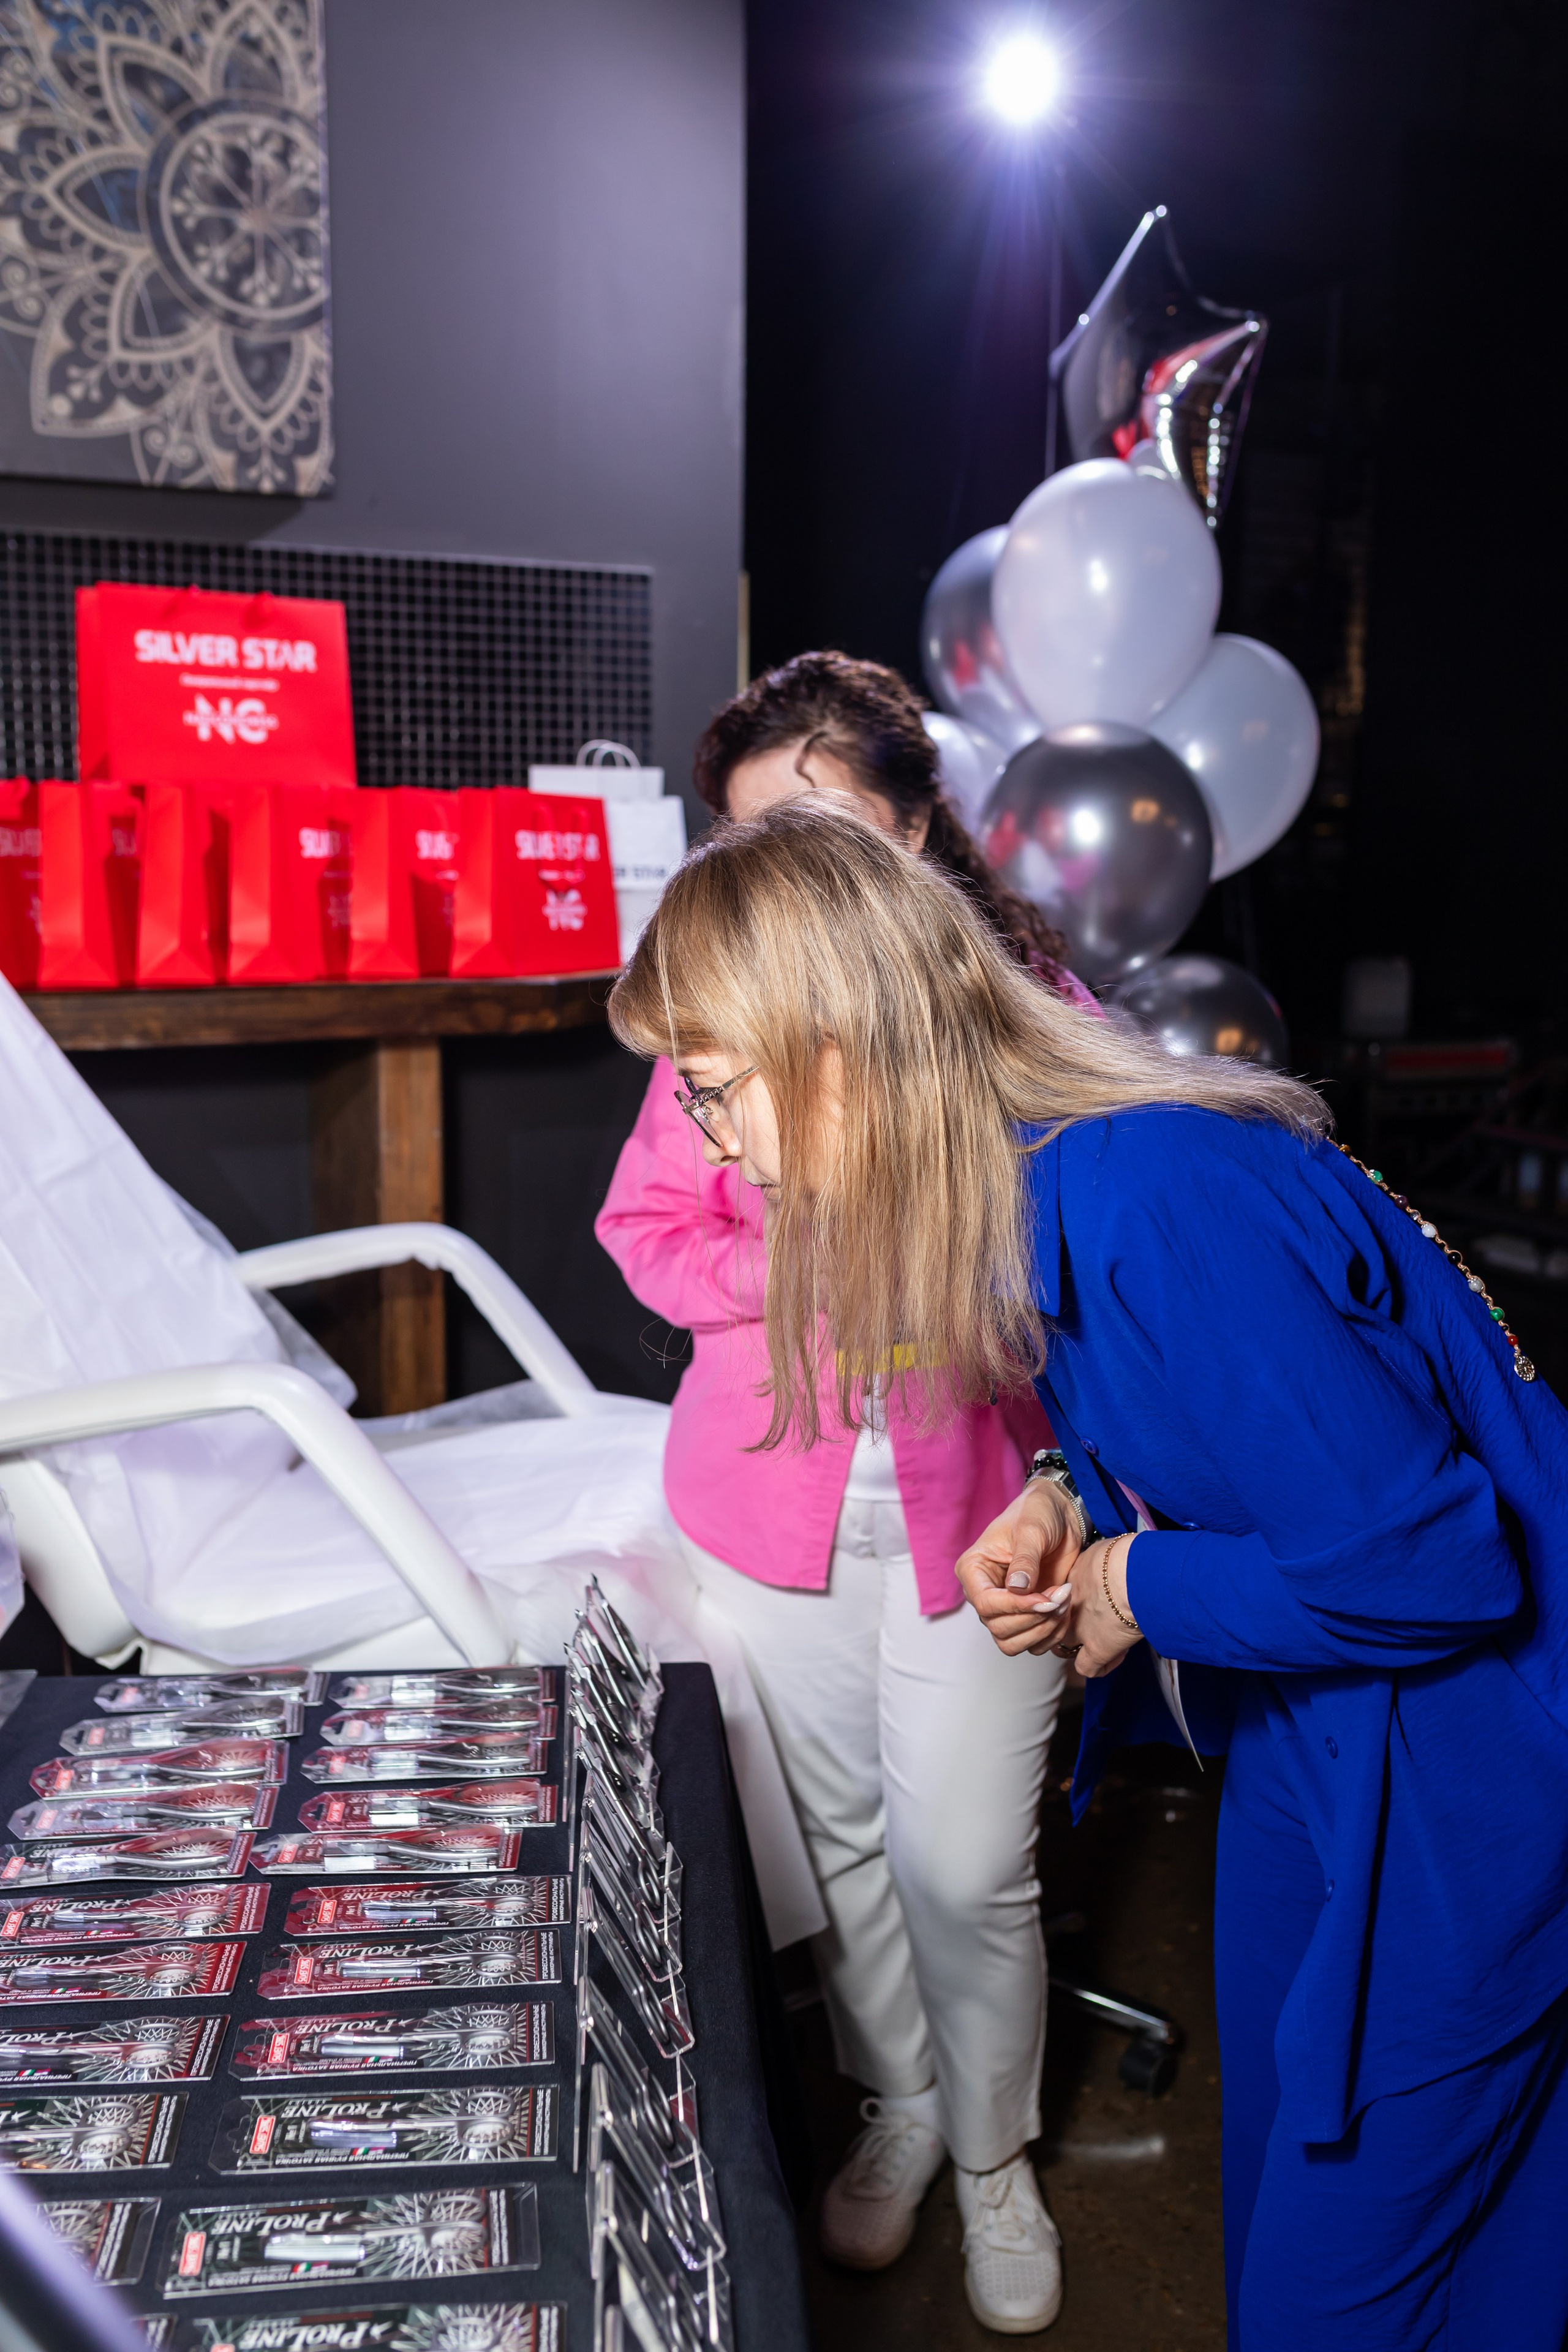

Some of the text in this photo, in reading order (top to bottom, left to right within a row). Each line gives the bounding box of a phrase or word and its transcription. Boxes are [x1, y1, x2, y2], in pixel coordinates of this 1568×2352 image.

[134, 629, 318, 673] SILVER STAR
[342, 1889, 432, 1901] PROLINE
[239, 1887, 254, 1931] ПРОФЕССИОНАЛЬНЫЕ
[318, 1944, 414, 1958] PROLINE
[212, 1944, 232, 1991] ПРОФЕССИОНАЛЬНЫЕ
[295, 2019, 398, 2034] PROLINE
[281, 2101, 391, 2120] PROLINE
[211, 2211, 331, 2236] PROLINE
